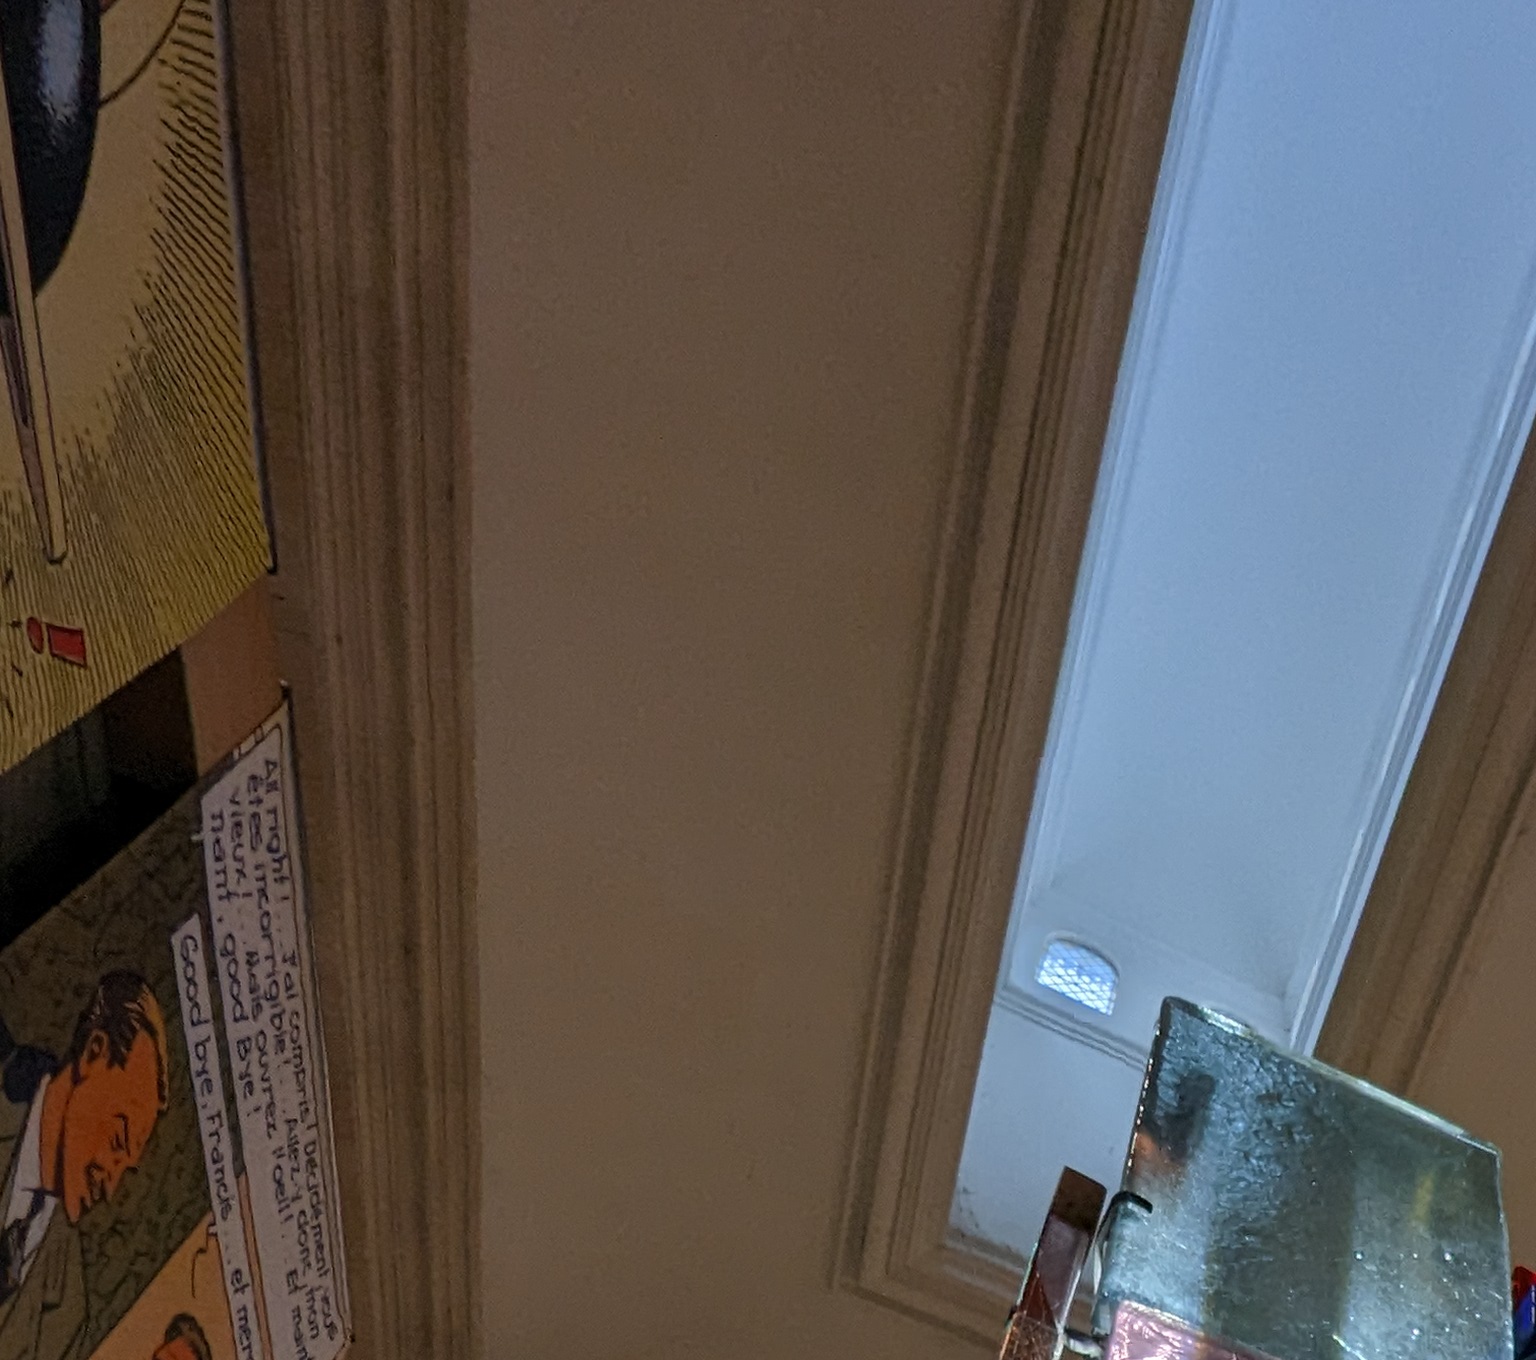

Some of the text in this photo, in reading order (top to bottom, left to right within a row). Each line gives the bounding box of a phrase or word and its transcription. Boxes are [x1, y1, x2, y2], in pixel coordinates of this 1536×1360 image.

[264, 758, 281, 795] All
[182, 936, 208, 1027] Good
[219, 932, 249, 1023] good
[193, 1035, 213, 1109] bye,
[245, 950, 263, 1021] Mais
[255, 1029, 277, 1139] ouvrez
[285, 1268, 302, 1295] Et
[230, 1267, 250, 1294] et
[304, 1287, 319, 1339] mon
